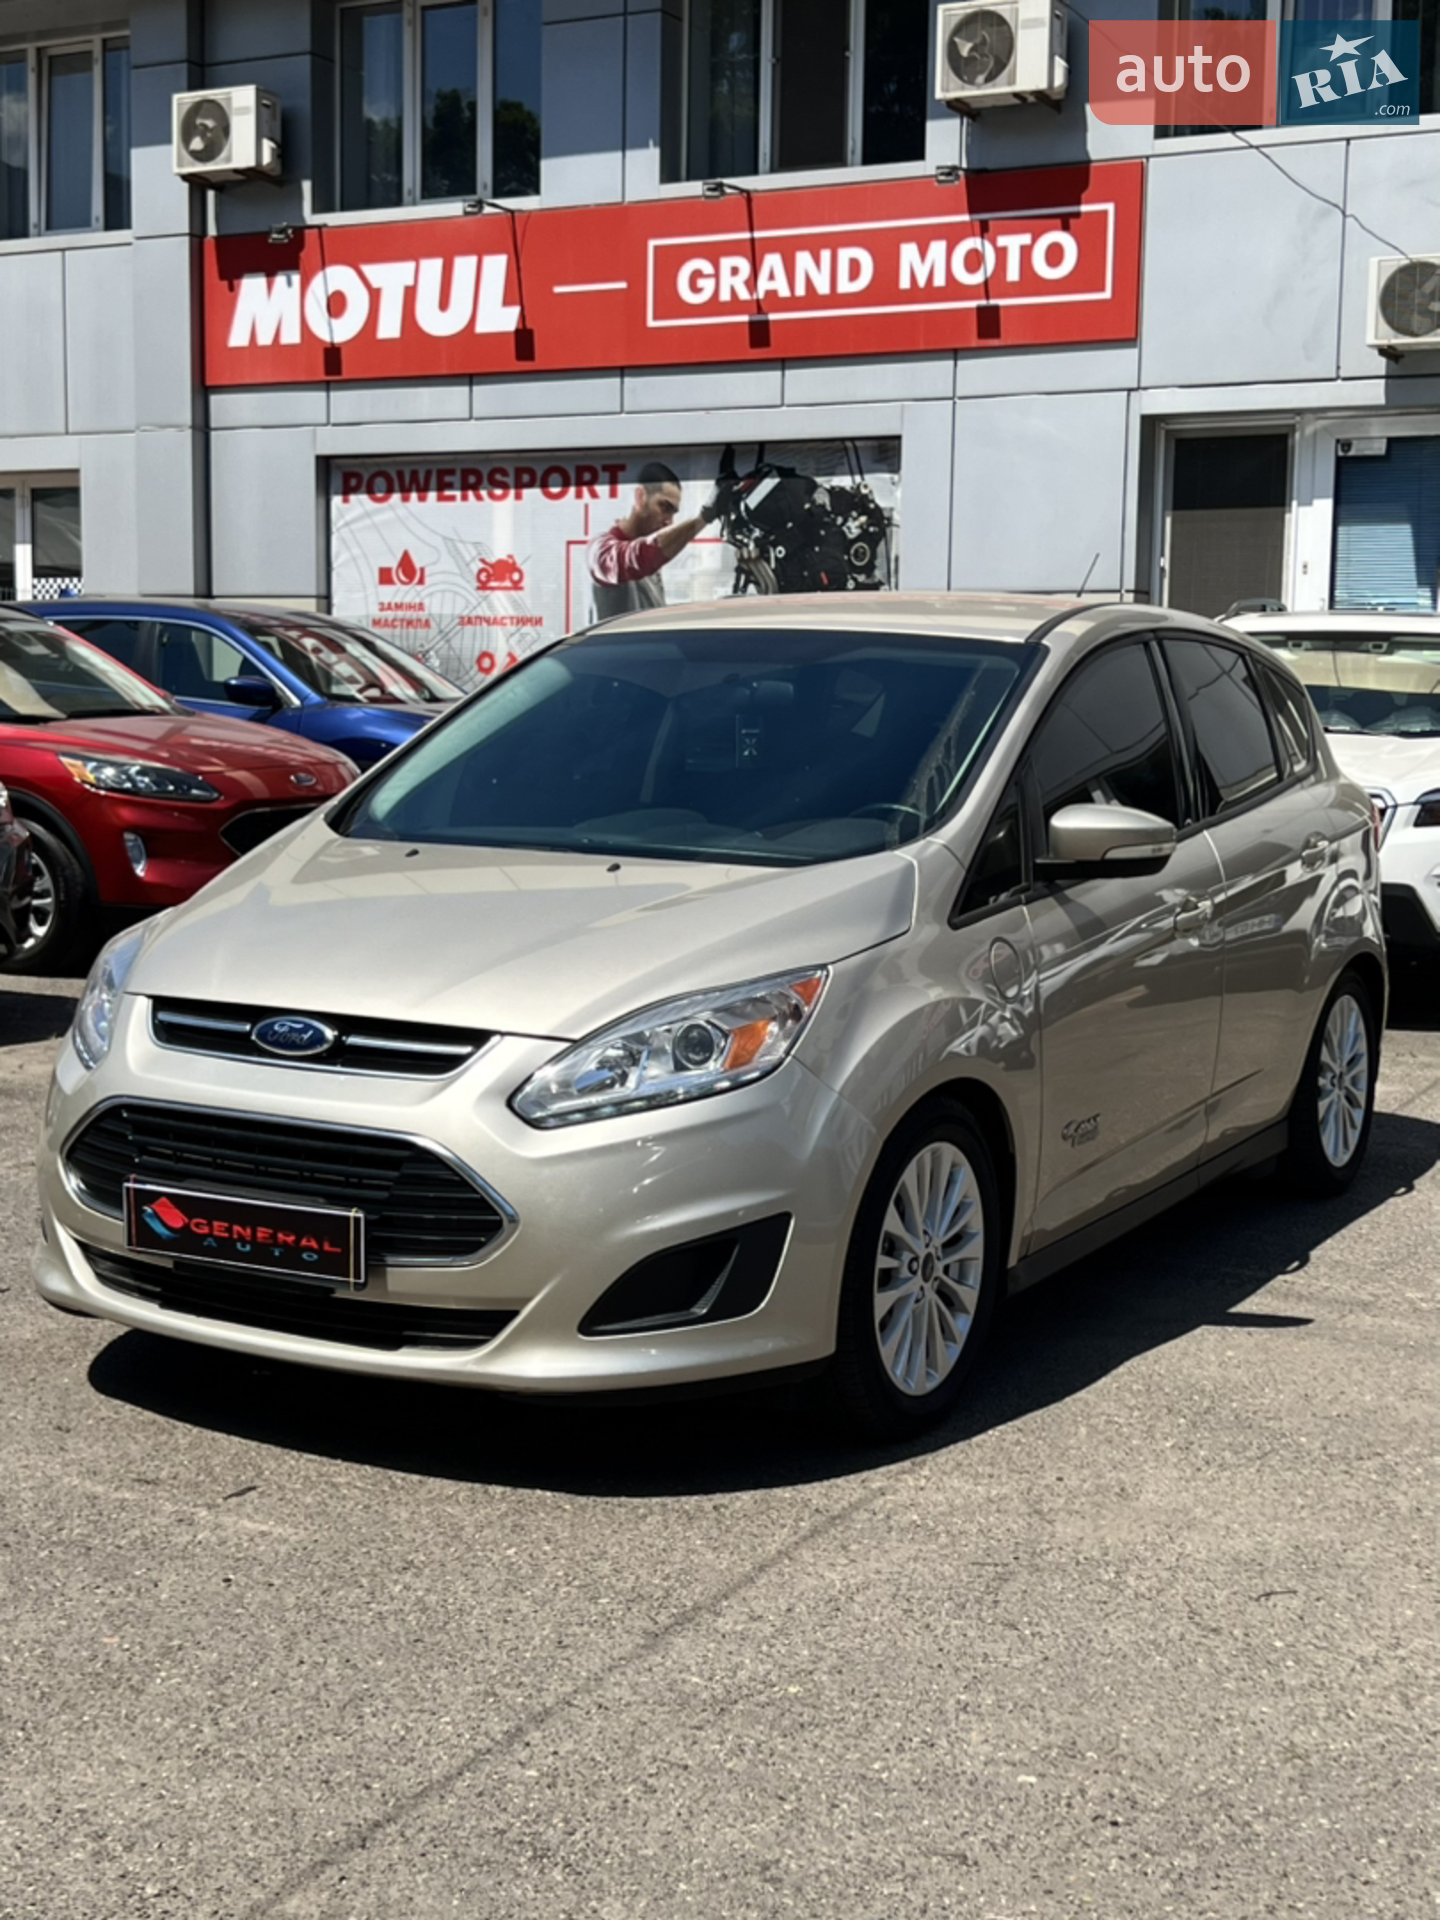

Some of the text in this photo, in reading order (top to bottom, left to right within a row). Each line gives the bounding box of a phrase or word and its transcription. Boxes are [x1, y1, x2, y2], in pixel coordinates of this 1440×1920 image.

[676, 230, 1078, 305] GRAND MOTO
[228, 254, 521, 348] MOTUL
[341, 463, 627, 504] POWERSPORT
[378, 602, 425, 612] ЗАМІНА
[458, 615, 543, 627] ЗАПЧАСТИНИ
[372, 618, 431, 629] МАСТИЛА
[267, 1021, 313, 1045] Ford
[189, 1217, 342, 1253] GENERAL
